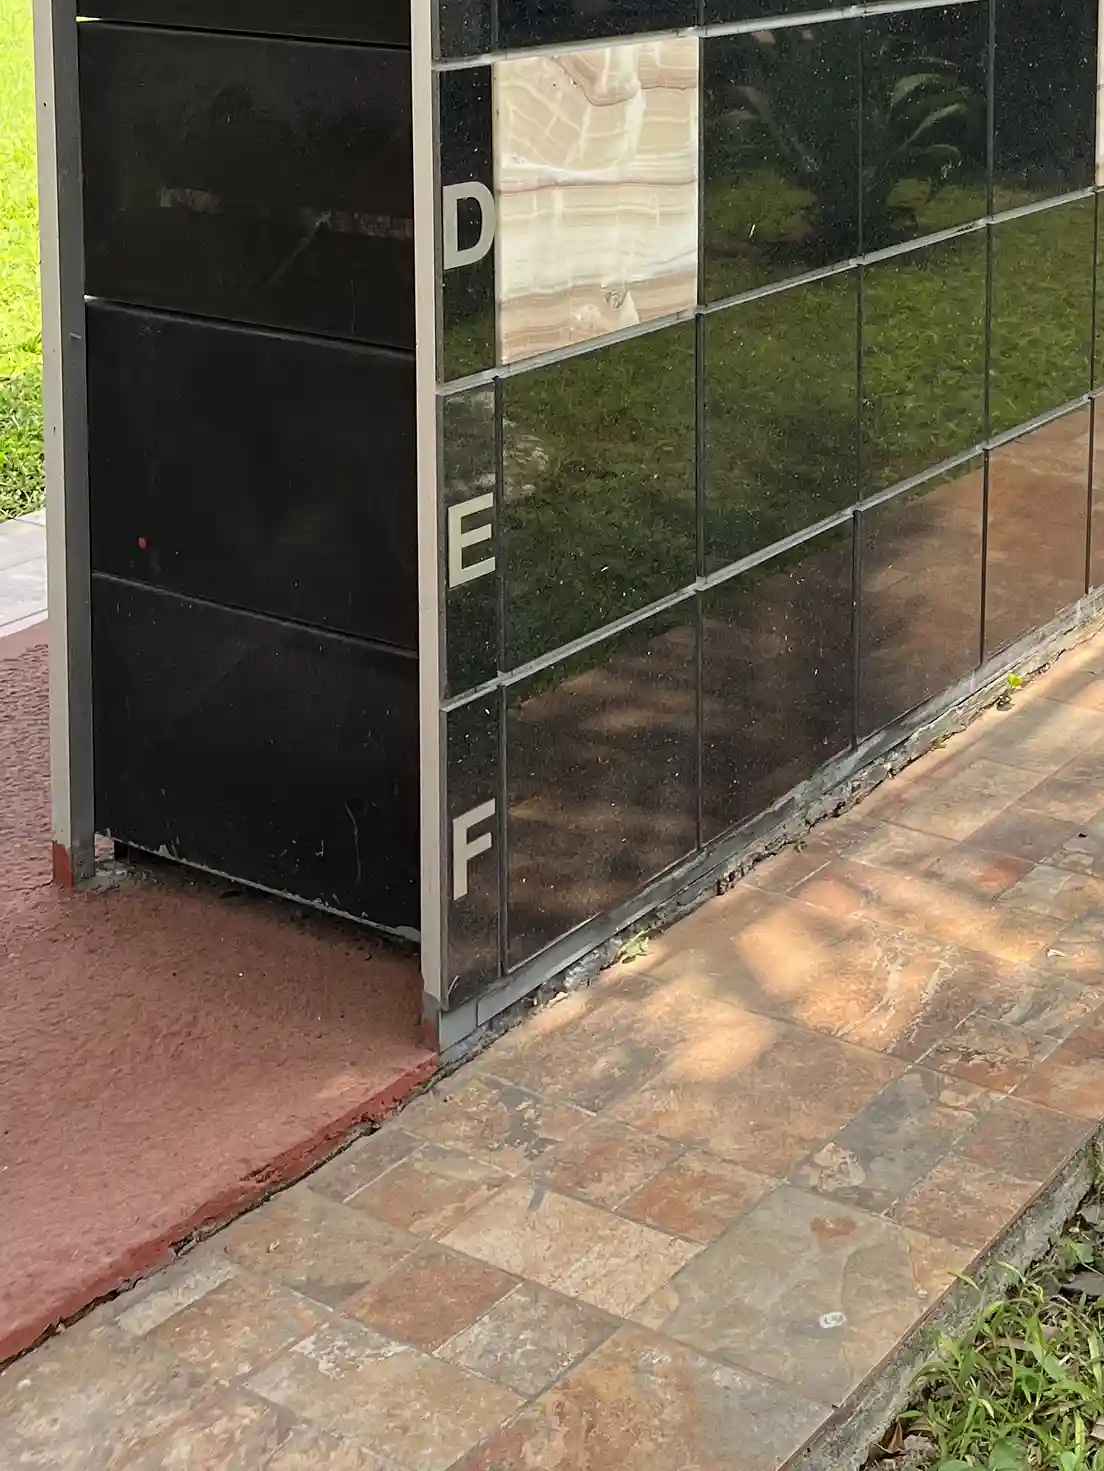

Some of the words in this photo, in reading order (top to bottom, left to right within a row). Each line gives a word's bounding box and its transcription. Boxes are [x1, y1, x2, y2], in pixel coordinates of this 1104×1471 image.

[443, 180, 496, 270] D
[447, 491, 496, 588] E
[452, 798, 496, 901] F
